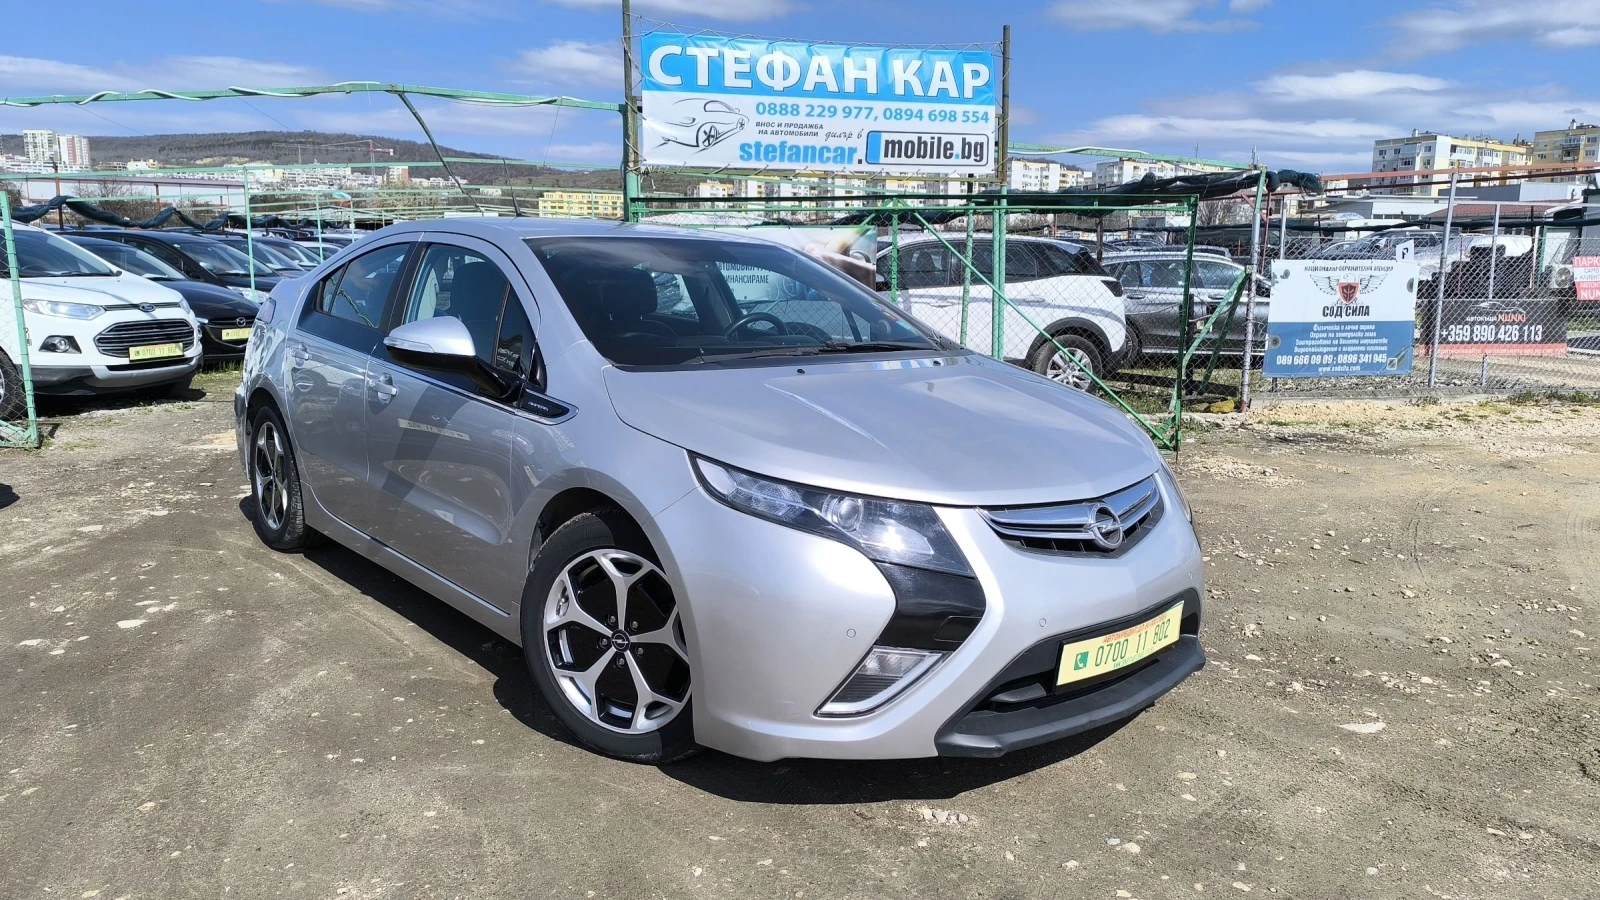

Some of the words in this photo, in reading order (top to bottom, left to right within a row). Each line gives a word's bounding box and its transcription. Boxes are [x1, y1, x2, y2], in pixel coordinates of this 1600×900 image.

[647, 44, 879, 96] СТЕФАН
[892, 58, 990, 100] КАР
[755, 101, 800, 117] 0888
[805, 104, 838, 118] 229
[842, 105, 878, 121] 977,
[883, 107, 925, 121] 0894
[928, 109, 958, 122] 698
[961, 111, 990, 124] 554
[784, 122, 824, 130] ПРОДАЖБА
[739, 140, 863, 165] stefancar.
[883, 136, 985, 162] mobile.bg
[724, 274, 769, 284] ИНАНСИРАМЕ
[1322, 305, 1343, 319] СОД
[1344, 305, 1370, 317] СИЛА
[1441, 324, 1471, 341] +359
[1473, 324, 1496, 341] 890
[1497, 324, 1520, 341] 426
[1522, 324, 1543, 341] 113
[1276, 355, 1292, 365] 089
[1310, 354, 1322, 365] 09
[1337, 354, 1358, 364] 0896
[1358, 353, 1372, 364] 341
[1372, 353, 1387, 363] 945
[1095, 638, 1129, 667] 0700
[1136, 630, 1148, 654] 11
[1153, 618, 1171, 645] 802
